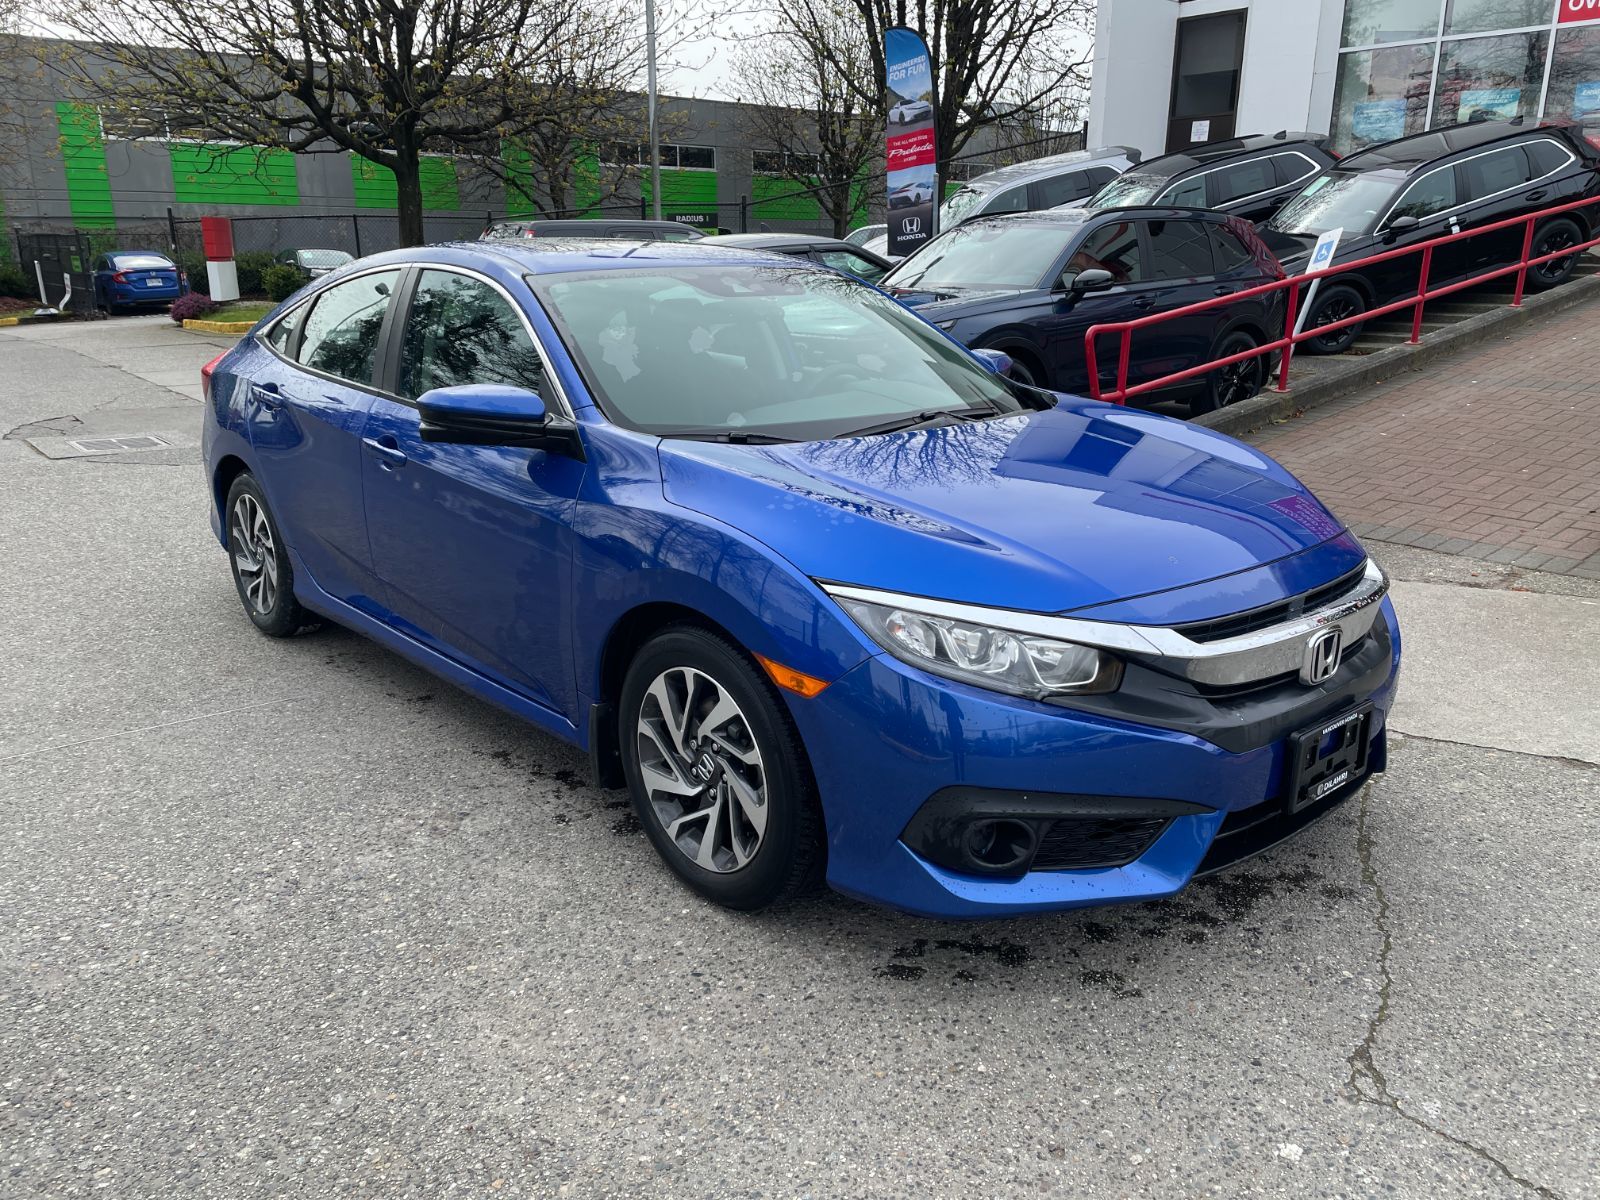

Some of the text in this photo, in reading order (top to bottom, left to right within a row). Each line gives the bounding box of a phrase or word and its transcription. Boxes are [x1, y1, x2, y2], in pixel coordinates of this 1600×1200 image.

[889, 55, 926, 72] ENGINEERED
[889, 62, 926, 83] FOR FUN
[889, 142, 933, 158] Prelude
[897, 232, 927, 241] HONDA
[1323, 712, 1358, 735] VANCOUVER HONDA
[1324, 770, 1348, 791] DILAWRI
